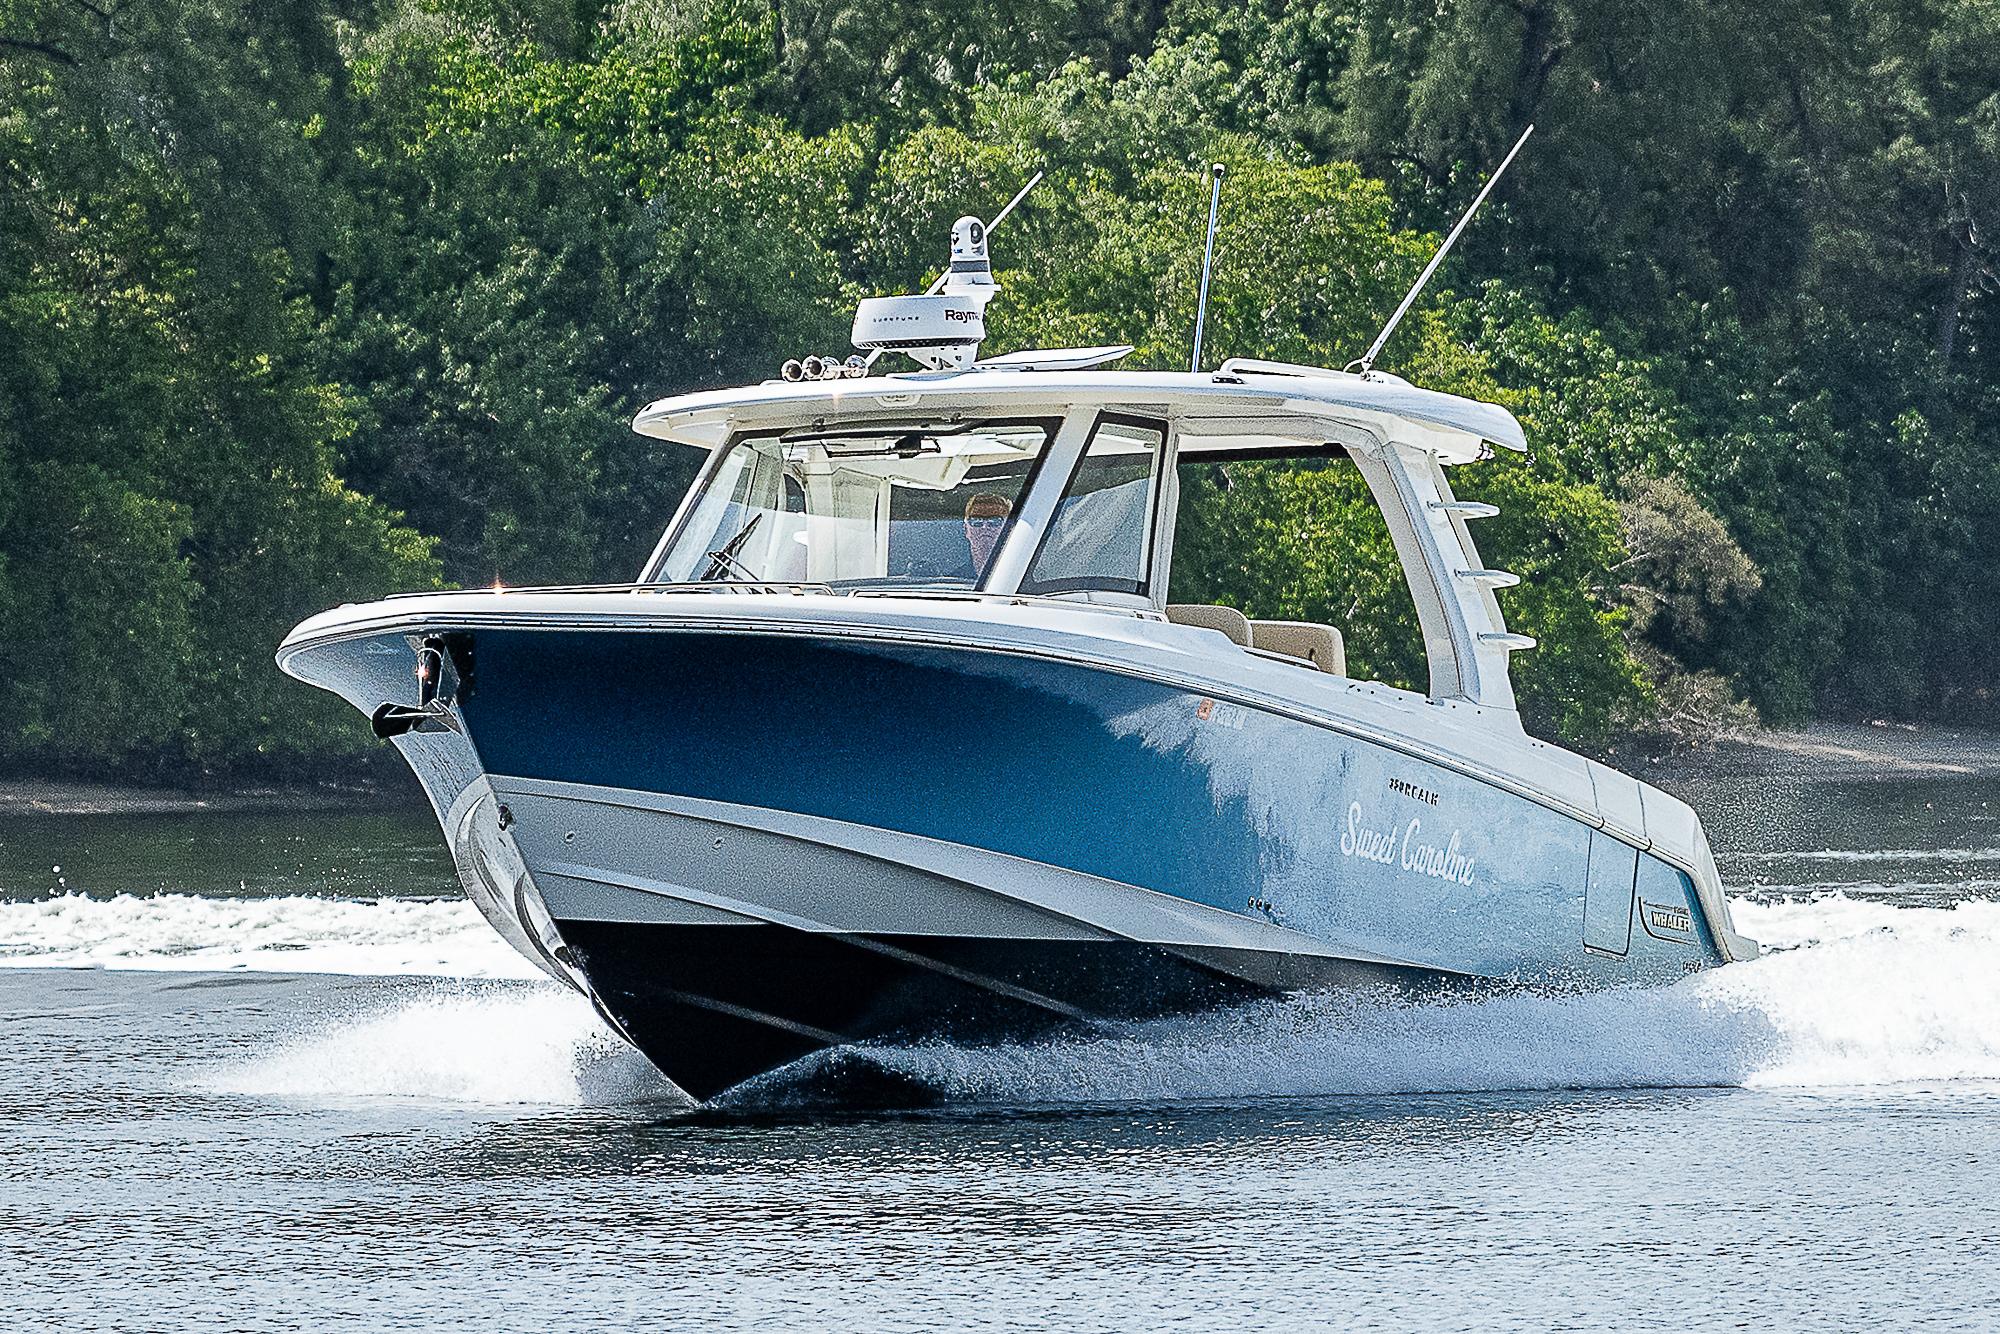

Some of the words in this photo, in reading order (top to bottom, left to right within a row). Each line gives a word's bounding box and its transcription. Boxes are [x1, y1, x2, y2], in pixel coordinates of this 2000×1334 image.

[1340, 801, 1398, 864] Sweet
[1401, 818, 1475, 886] Caroline
[1651, 911, 1690, 932] WHALER
